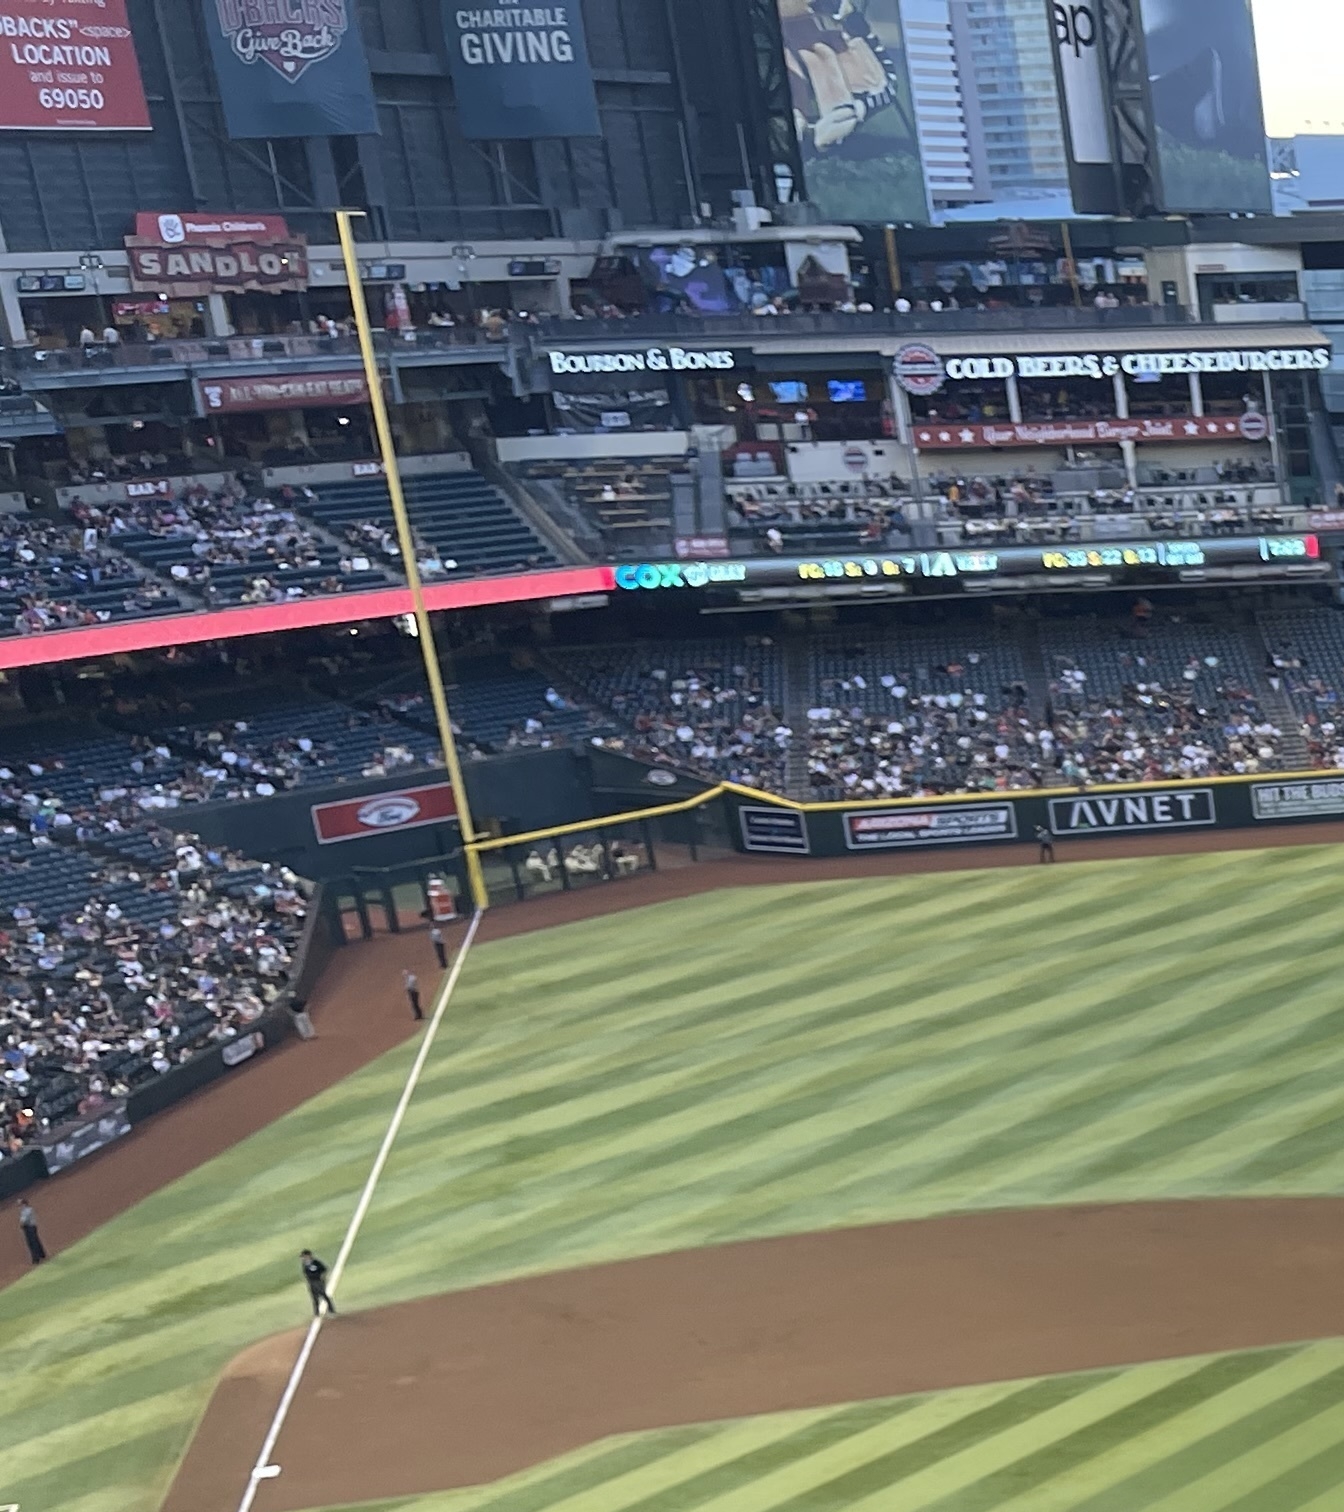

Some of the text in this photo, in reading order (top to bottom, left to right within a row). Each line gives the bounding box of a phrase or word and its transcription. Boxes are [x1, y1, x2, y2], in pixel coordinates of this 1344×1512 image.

[0, 15, 78, 39] BACKS"
[456, 8, 568, 28] CHARITABLE
[11, 44, 112, 66] LOCATION
[461, 30, 574, 64] GIVING
[39, 88, 105, 109] 69050
[138, 251, 300, 277] SANDLOT
[646, 348, 670, 371] &
[946, 358, 1014, 379] COLD
[1016, 354, 1103, 379] BEERS
[1103, 355, 1120, 376] &
[1121, 348, 1330, 375] CHEESEBURGERS
[615, 564, 684, 590] COX
[1070, 794, 1196, 828] AVNET
